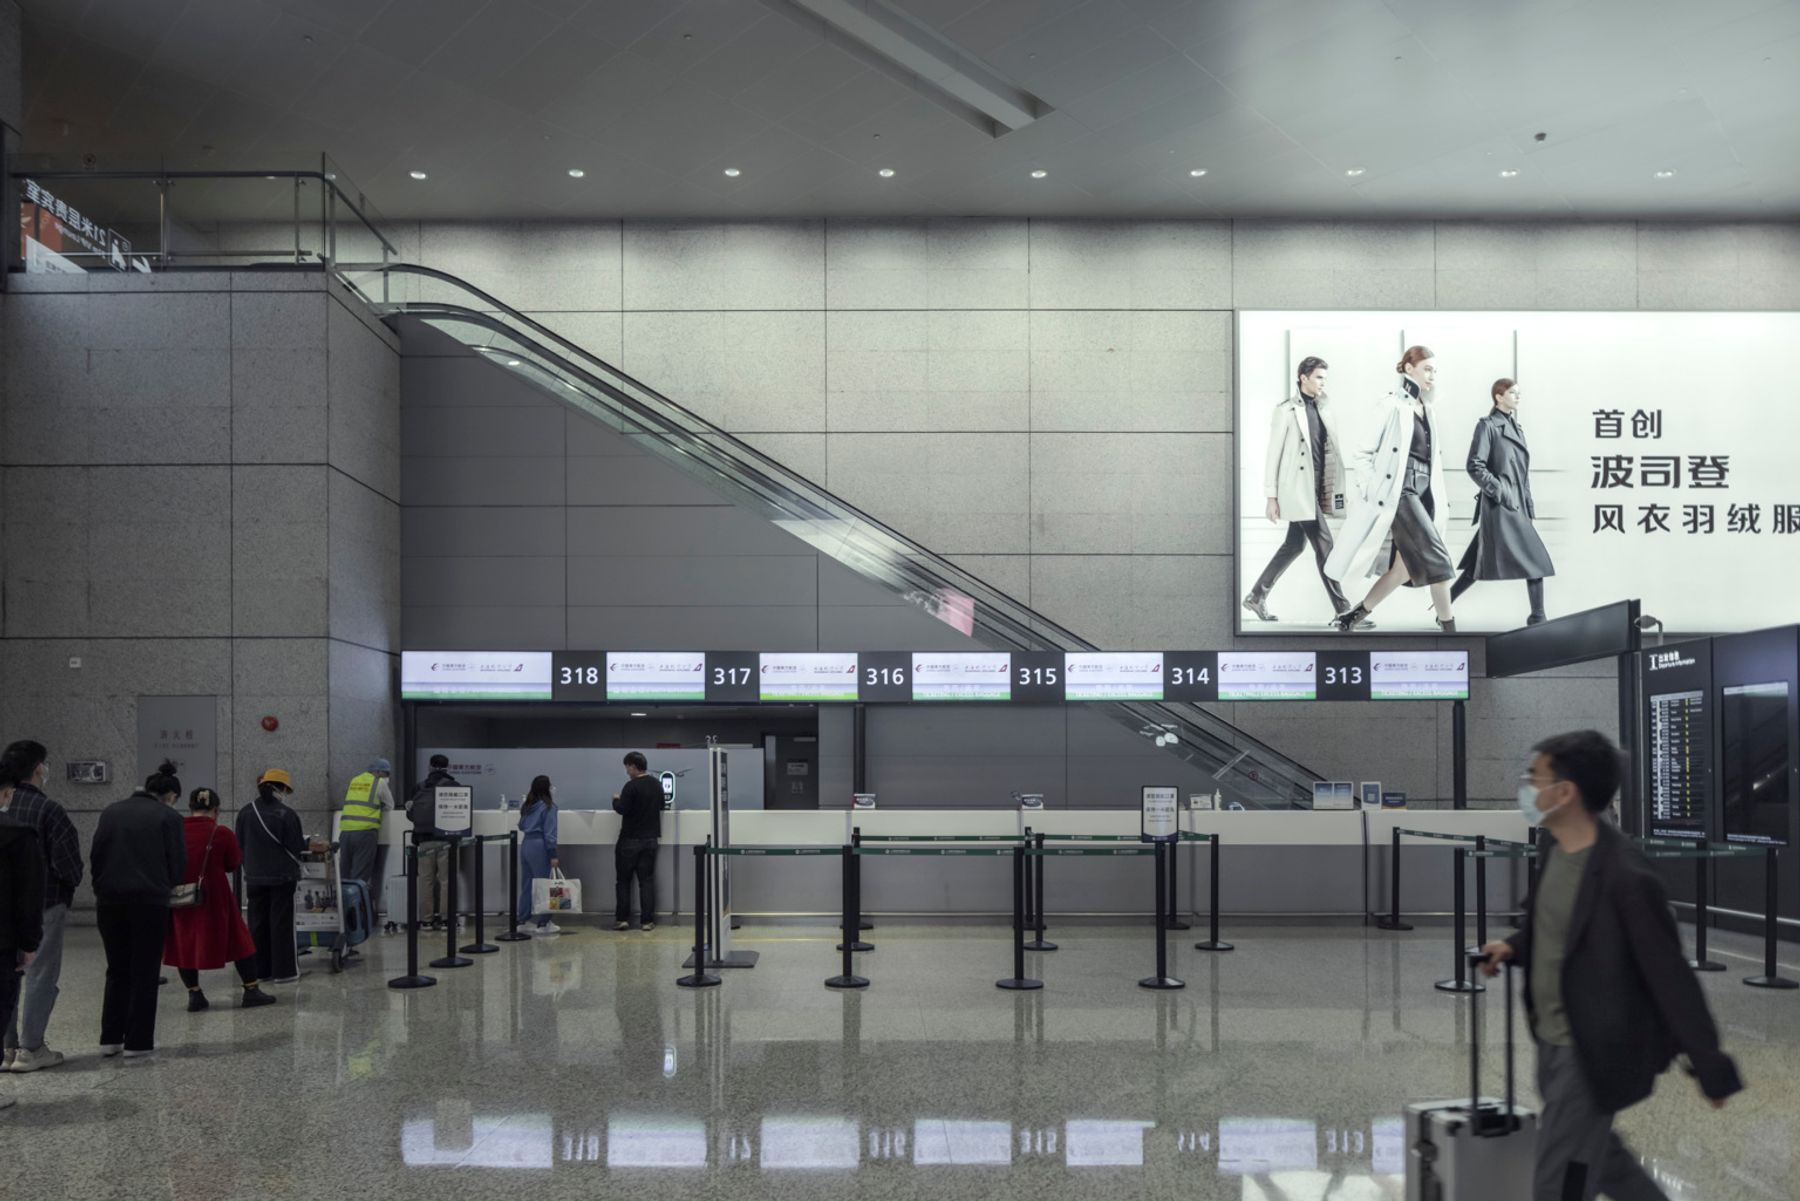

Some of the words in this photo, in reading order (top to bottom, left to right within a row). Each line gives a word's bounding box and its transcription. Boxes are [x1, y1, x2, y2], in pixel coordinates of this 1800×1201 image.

[1592, 409, 1662, 439] 首创
[1590, 454, 1730, 489] 波司登
[1592, 503, 1800, 534] 风衣羽绒服
[560, 666, 599, 685] 318
[713, 667, 751, 685] 317
[866, 667, 905, 686] 316
[1019, 667, 1057, 685] 315
[1171, 667, 1210, 685] 314
[1325, 666, 1362, 684] 313
